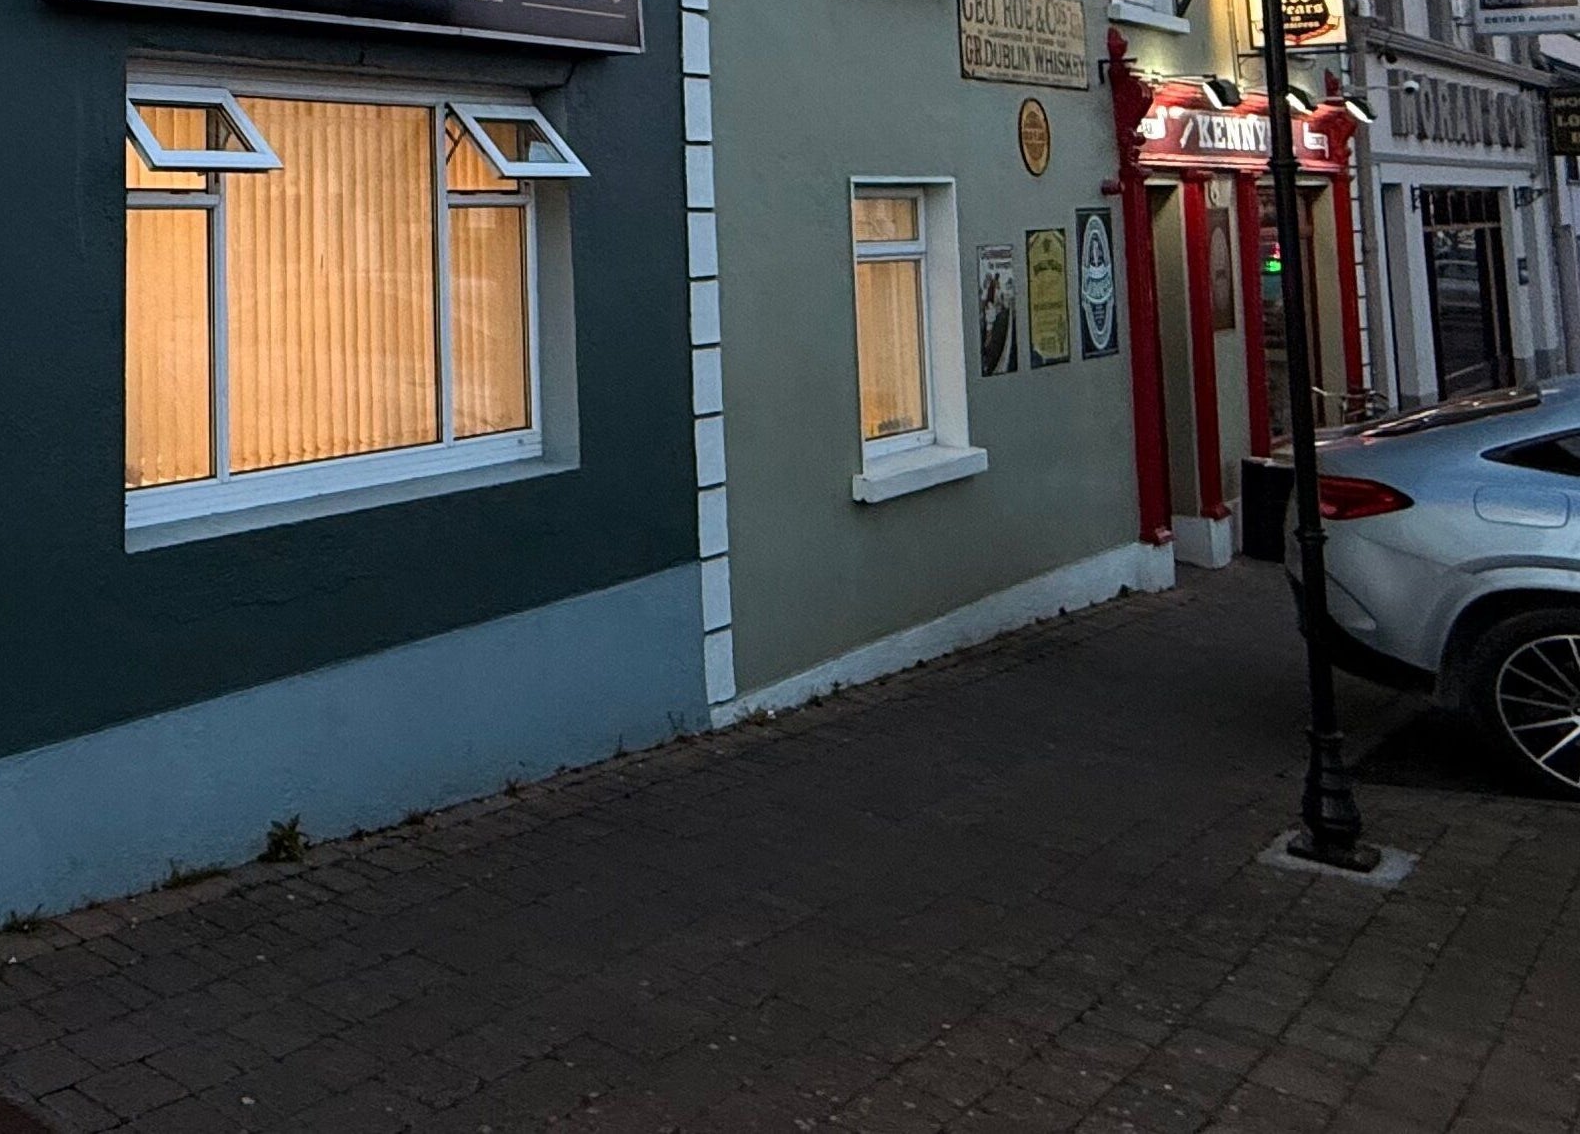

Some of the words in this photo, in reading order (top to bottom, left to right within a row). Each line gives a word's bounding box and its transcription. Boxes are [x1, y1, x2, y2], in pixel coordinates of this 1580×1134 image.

[1484, 15, 1526, 24] ESTATE
[984, 39, 1030, 72] DUBLIN
[1033, 46, 1085, 78] WHISKEY
